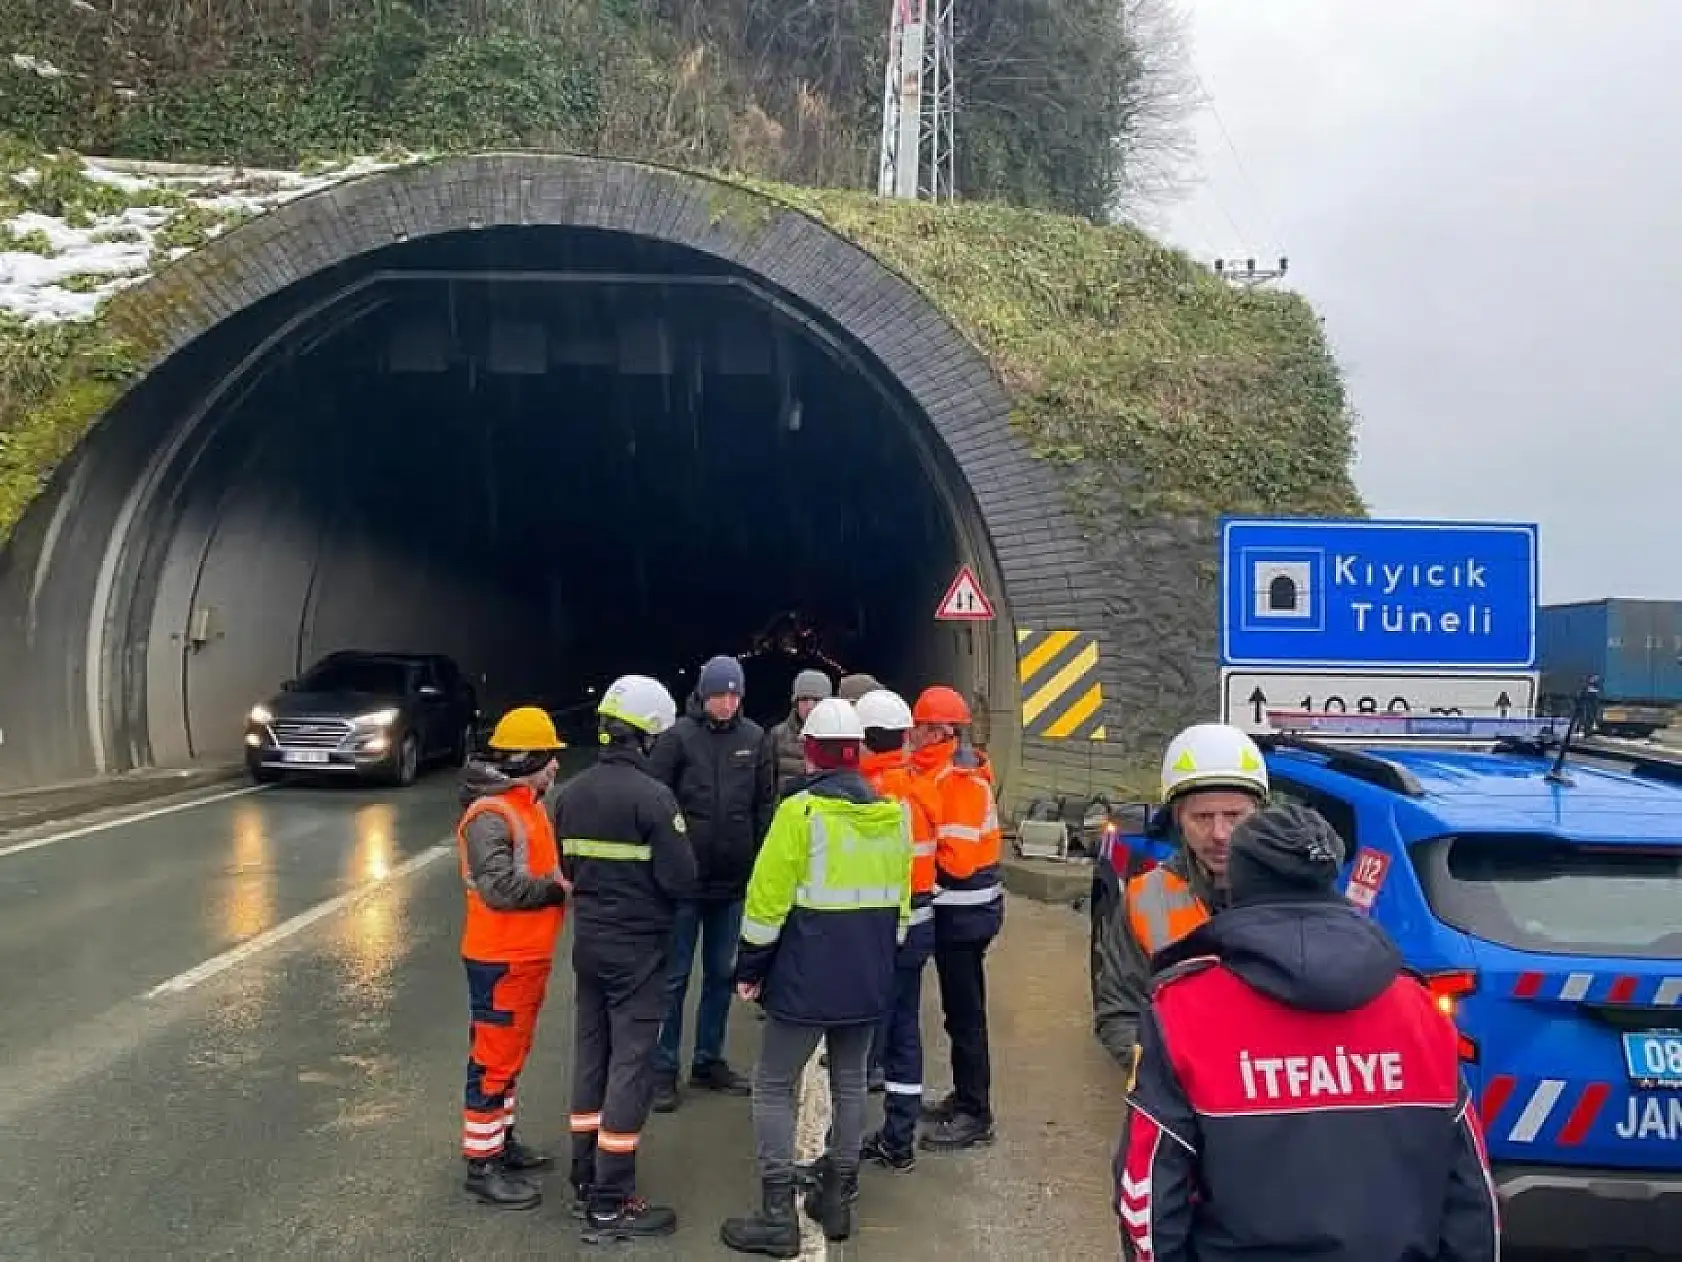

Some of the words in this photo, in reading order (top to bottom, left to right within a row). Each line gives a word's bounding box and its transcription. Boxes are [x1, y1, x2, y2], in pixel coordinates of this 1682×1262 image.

[1335, 554, 1487, 595] Kıyıcık
[1351, 602, 1492, 635] Tüneli
[1239, 1046, 1403, 1099] İTFAİYE
